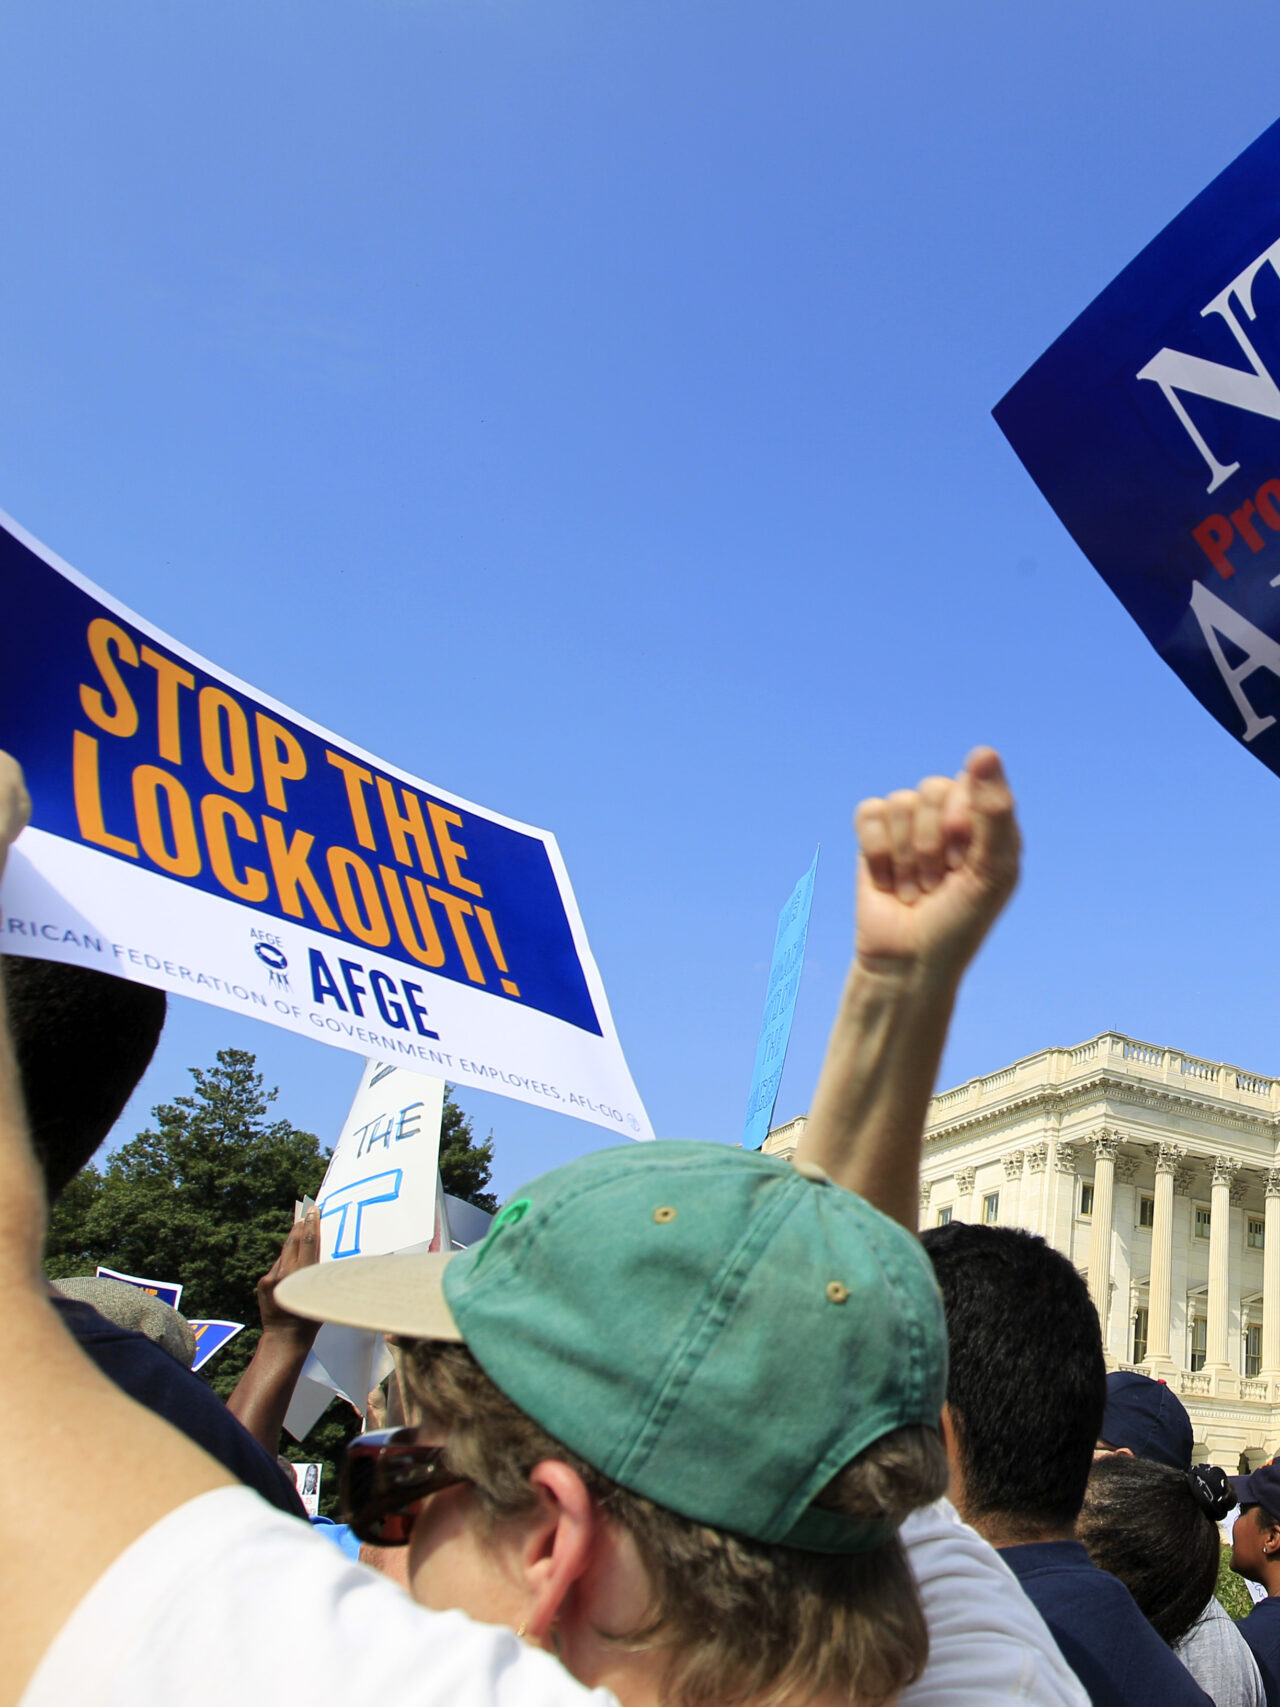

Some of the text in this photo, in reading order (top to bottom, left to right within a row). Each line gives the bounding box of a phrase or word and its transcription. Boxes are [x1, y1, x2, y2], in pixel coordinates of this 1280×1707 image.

[79, 618, 483, 898] STOP THE
[73, 730, 521, 997] LOCKOUT!
[250, 927, 284, 949] AFGE
[0, 917, 624, 1123] RICAN FEDERATION OF GOVERNMENT EMPLOYEES, AFL-CIO
[308, 946, 441, 1042] AFGE
[353, 1101, 425, 1159] THE
